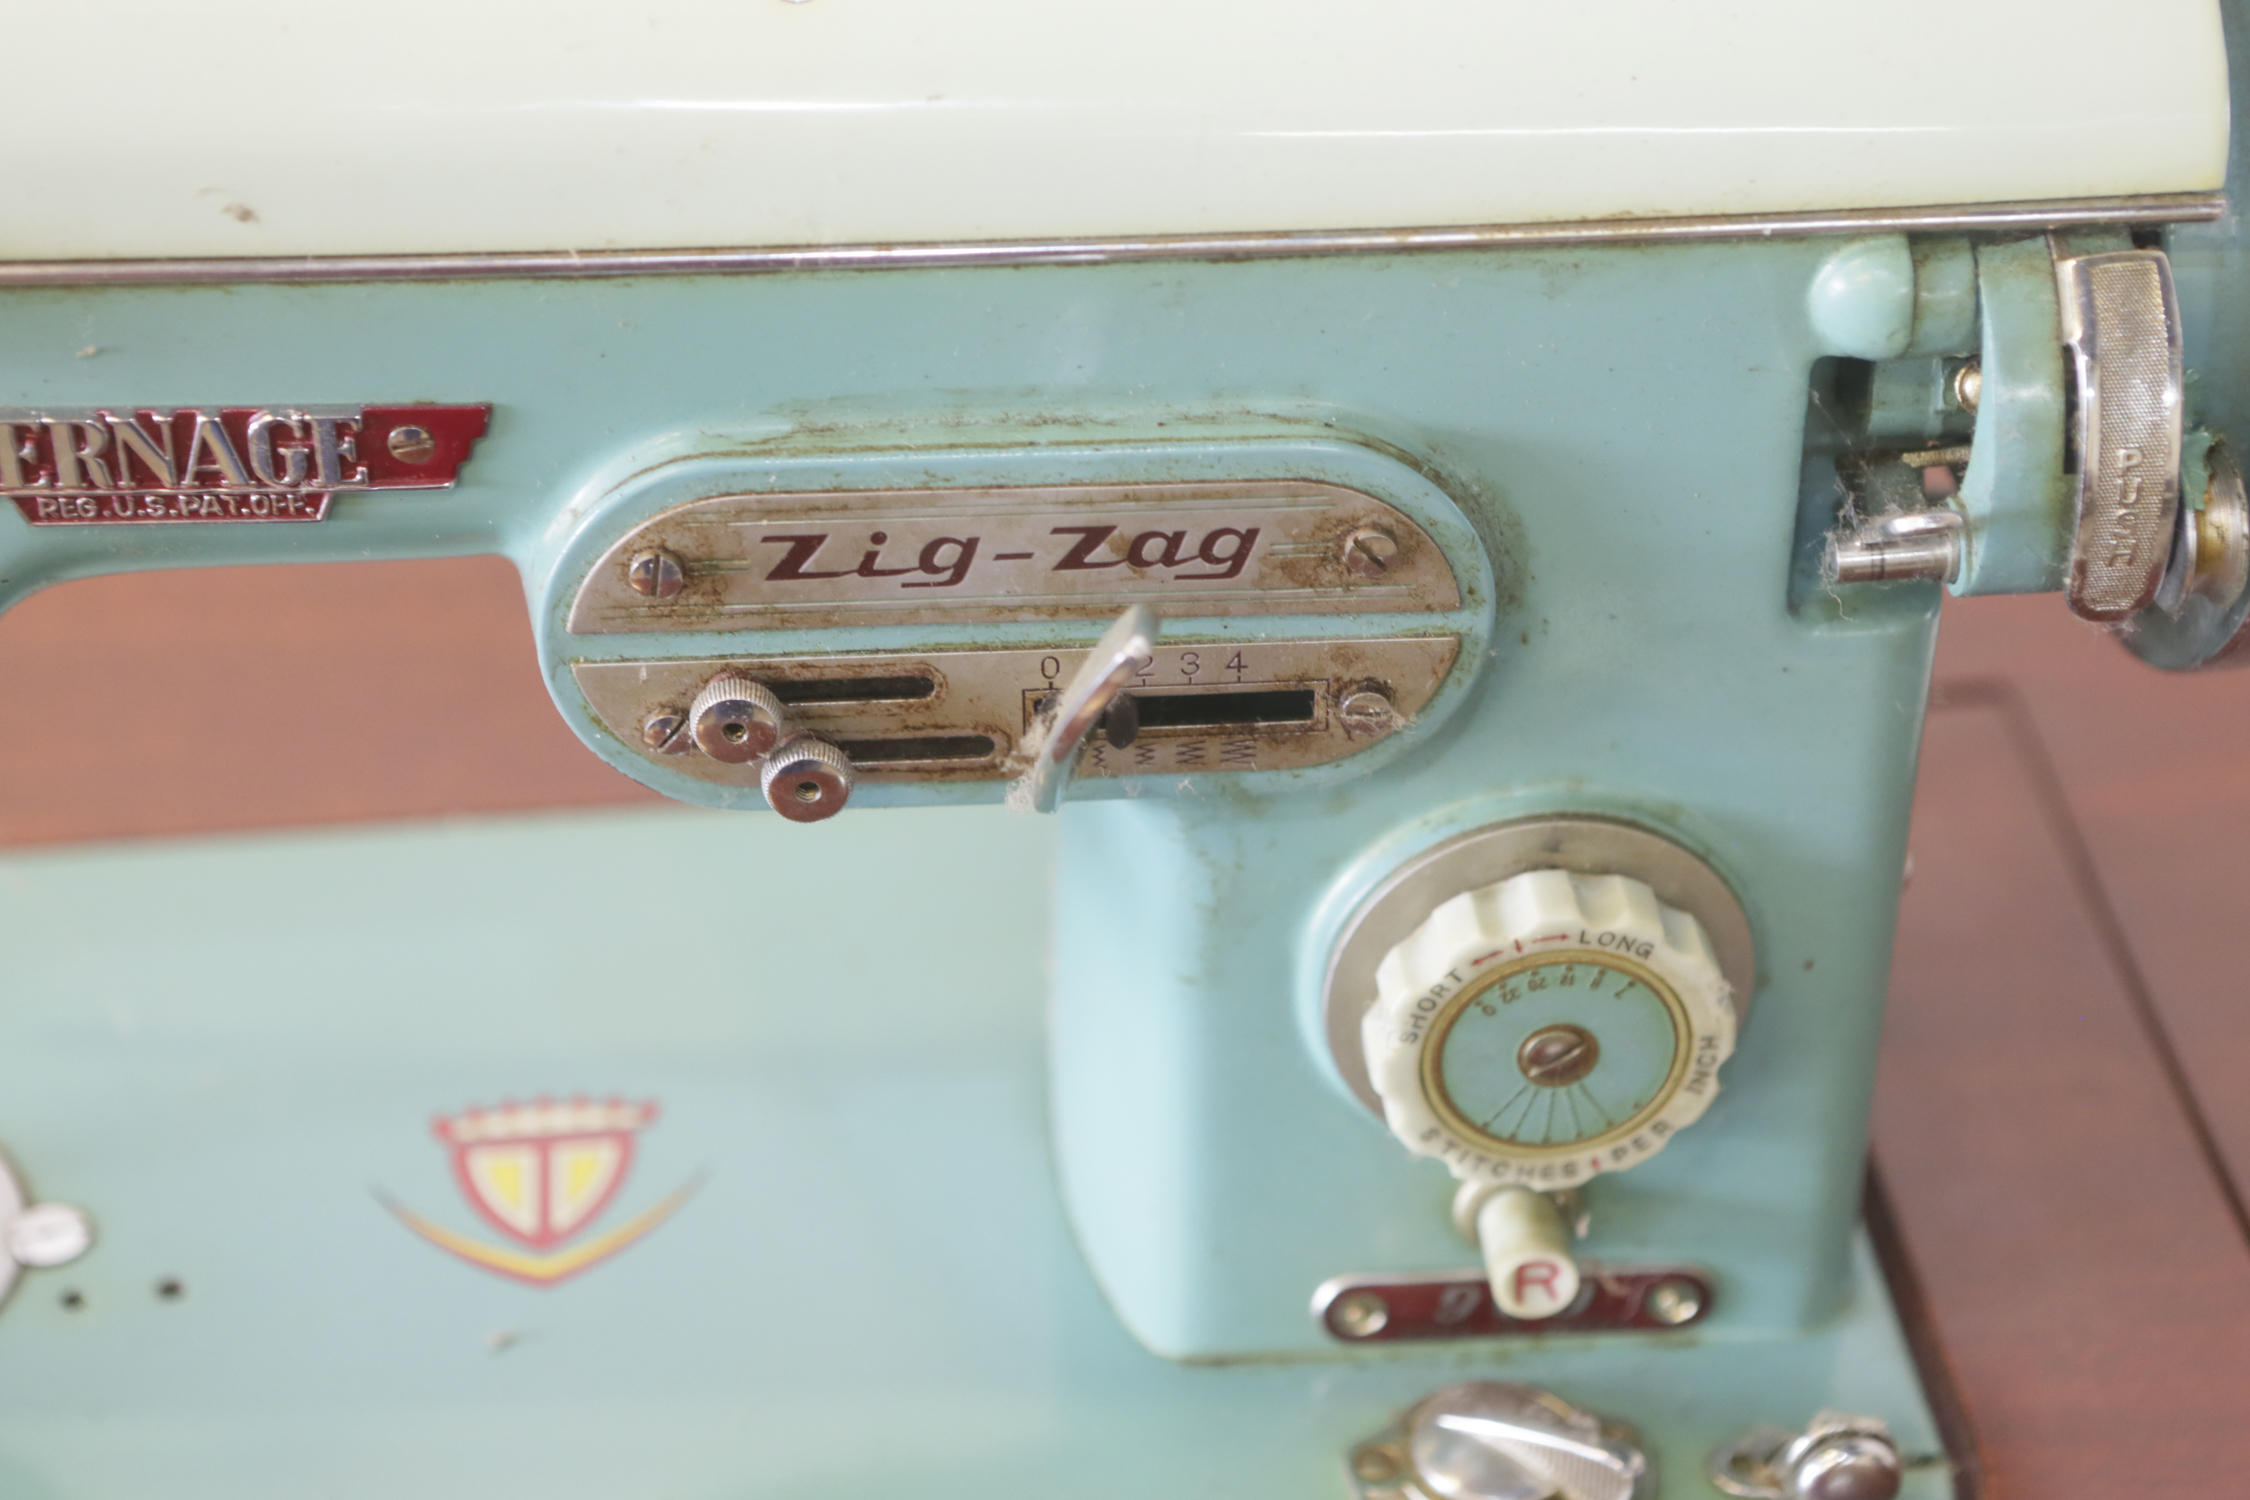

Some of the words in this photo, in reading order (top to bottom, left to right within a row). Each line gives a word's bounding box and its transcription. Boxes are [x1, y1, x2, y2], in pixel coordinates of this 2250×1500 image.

[2107, 447, 2143, 569] PUSH
[1040, 656, 1061, 680] 0
[1134, 655, 1155, 677] 2
[1180, 651, 1200, 676] 3
[1225, 649, 1249, 674] 4
[1579, 930, 1655, 960] LONG
[1400, 967, 1464, 1044] SHORT
[1420, 1126, 1579, 1179] STITCHES
[1611, 1119, 1670, 1162] PER
[1685, 1035, 1719, 1096] INCH
[1514, 1260, 1560, 1307] R
